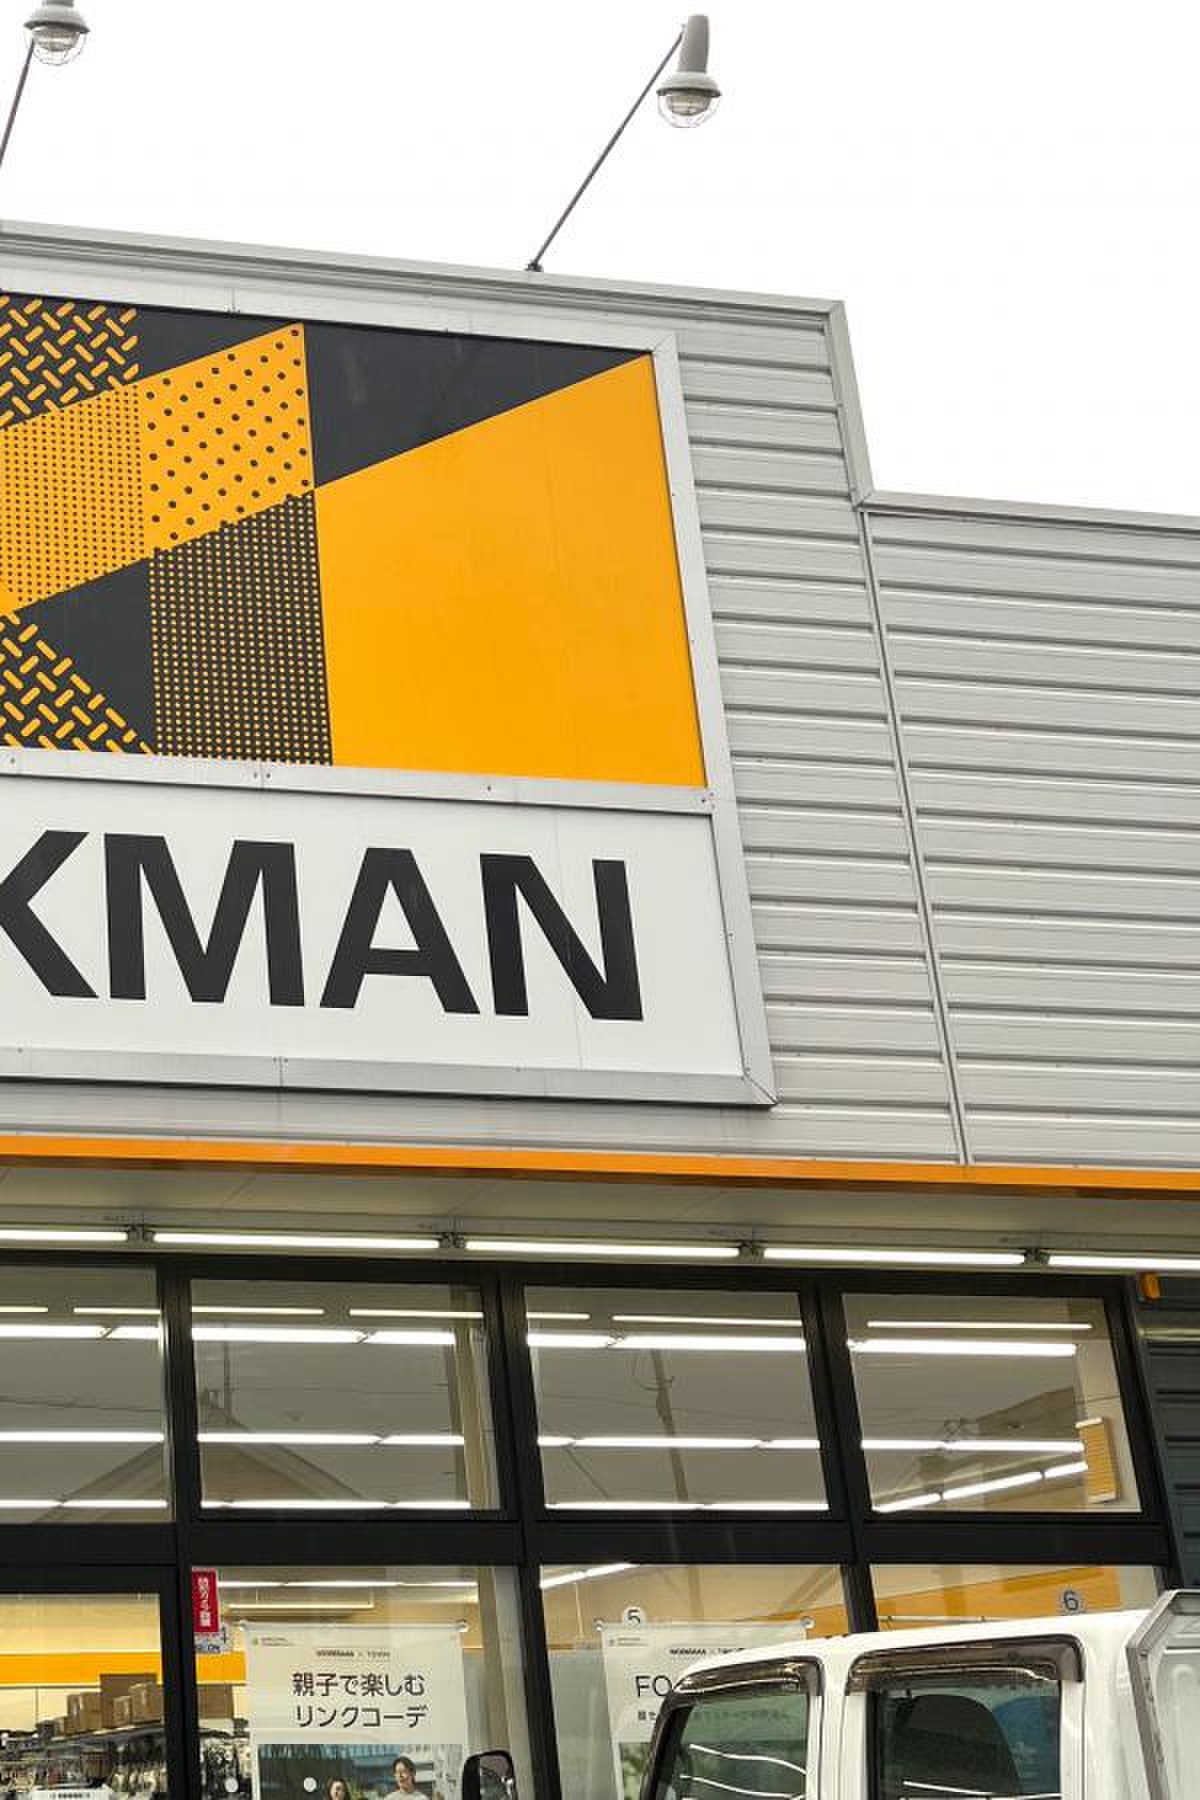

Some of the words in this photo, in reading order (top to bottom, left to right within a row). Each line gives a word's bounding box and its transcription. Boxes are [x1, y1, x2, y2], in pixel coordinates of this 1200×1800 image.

[1063, 1590, 1078, 1611] 6
[627, 1609, 641, 1624] 5
[292, 1672, 426, 1697] 親子で楽しむ
[296, 1704, 429, 1728] リンクコーデ
